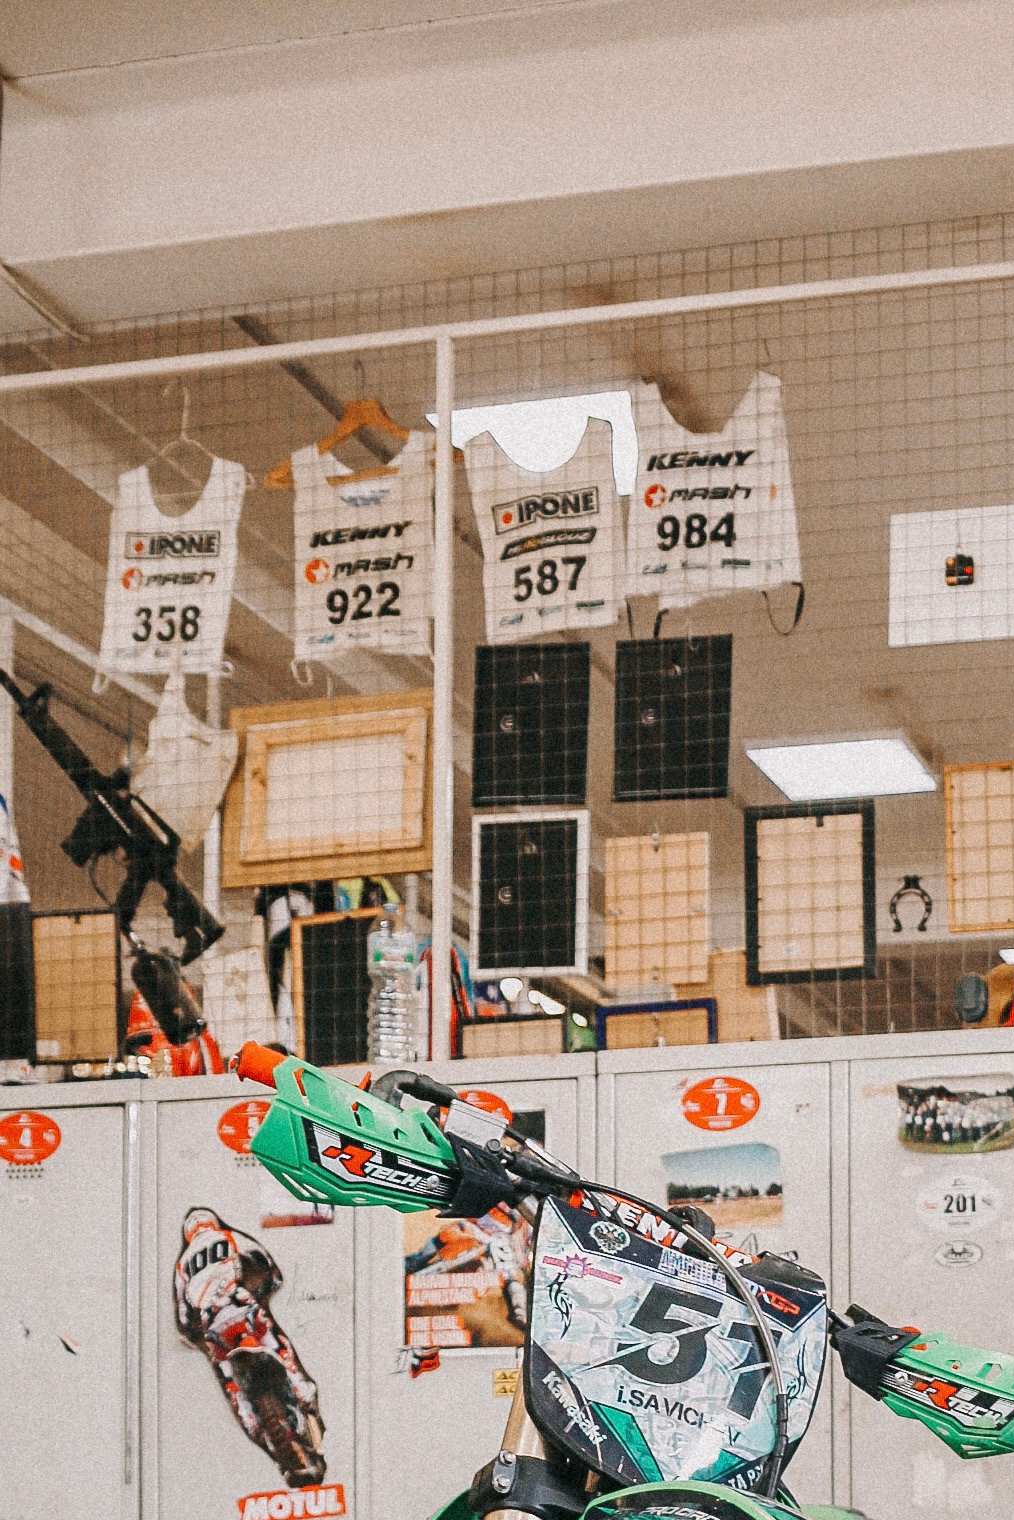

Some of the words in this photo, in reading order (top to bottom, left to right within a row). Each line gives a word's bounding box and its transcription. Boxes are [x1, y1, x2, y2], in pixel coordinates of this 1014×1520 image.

[647, 450, 754, 471] KENNY
[517, 491, 595, 523] IPONE
[149, 533, 217, 557] IPONE
[309, 520, 413, 548] KENNY
[656, 512, 736, 551] 984
[513, 556, 587, 602] 587
[326, 581, 401, 624] 922
[132, 606, 201, 642] 358
[715, 1093, 728, 1116] 1
[944, 1194, 977, 1214] 201
[542, 1370, 608, 1445] Kawasaki
